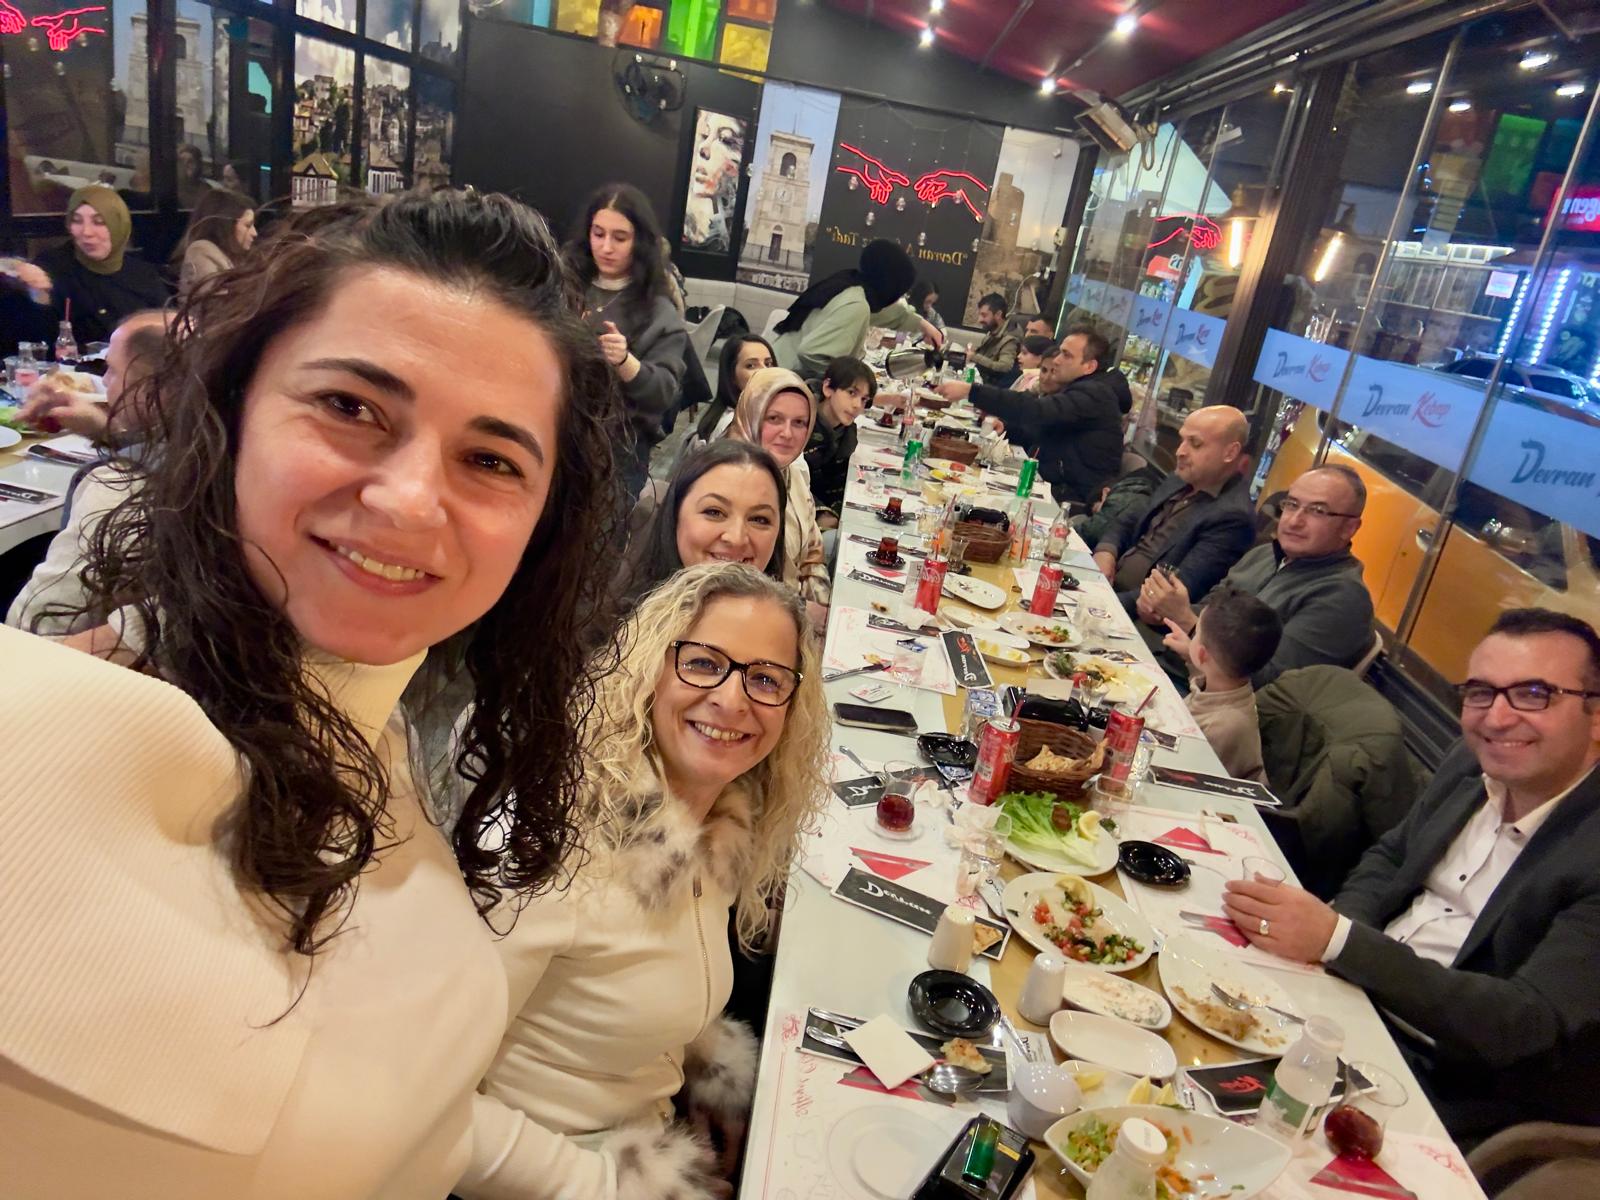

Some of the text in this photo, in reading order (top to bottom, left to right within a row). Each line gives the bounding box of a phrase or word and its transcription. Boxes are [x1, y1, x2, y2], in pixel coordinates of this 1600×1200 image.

[1273, 351, 1305, 379] Devran
[1361, 383, 1451, 429] Devran Kebap
[1511, 437, 1596, 490] Devran
